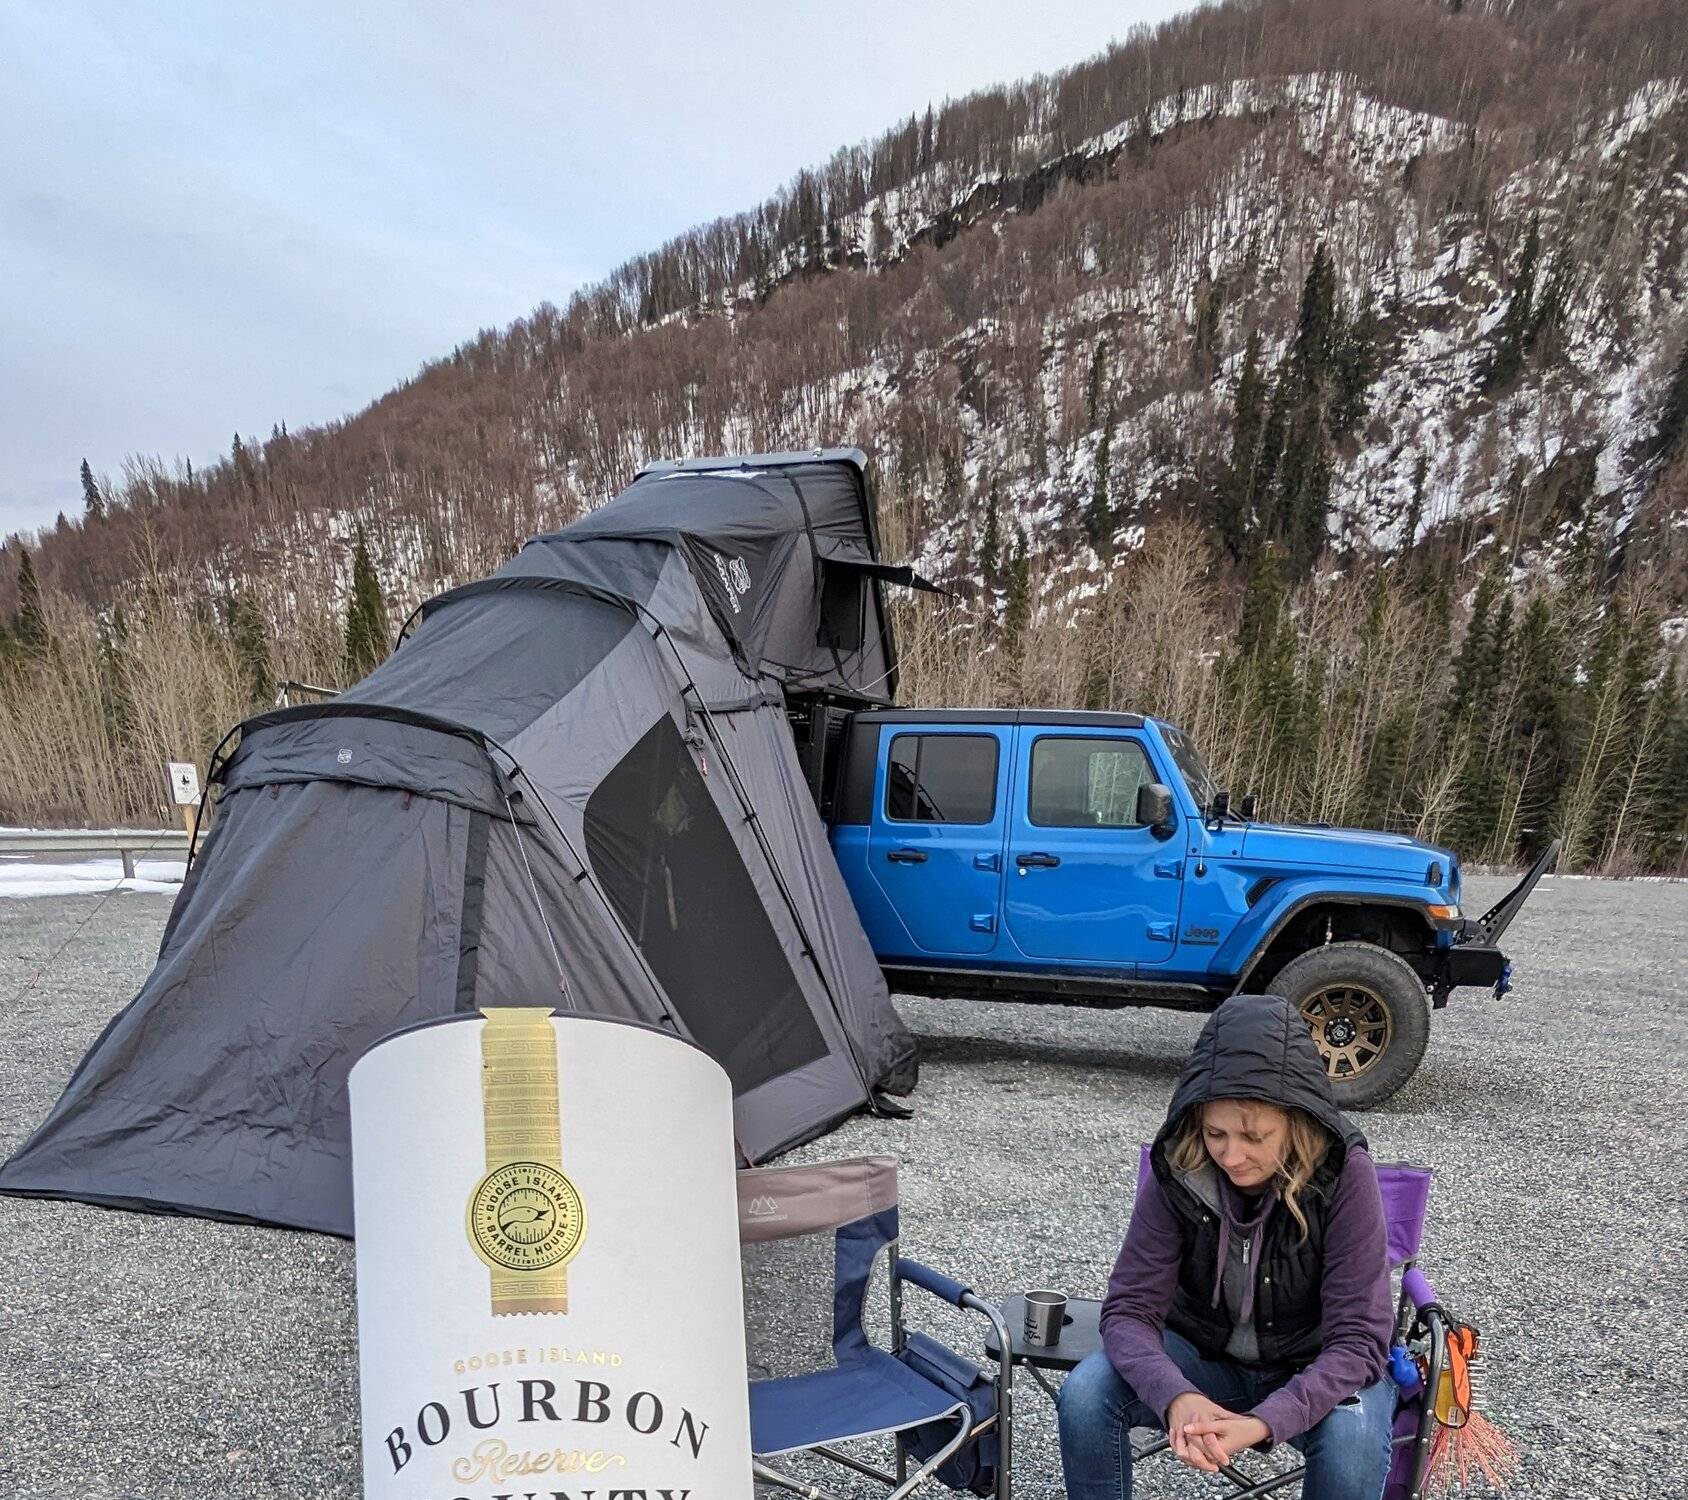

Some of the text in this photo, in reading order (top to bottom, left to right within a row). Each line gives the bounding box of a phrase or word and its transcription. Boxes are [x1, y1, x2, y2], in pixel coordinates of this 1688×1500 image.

[1184, 923, 1219, 940] Jeep
[486, 1176, 520, 1212] GOOSE
[486, 1222, 568, 1257] BARREL HOUSE
[453, 1347, 624, 1375] GOOSE ISLAND
[383, 1379, 710, 1476] BOURBON
[452, 1437, 626, 1485] Reserve
